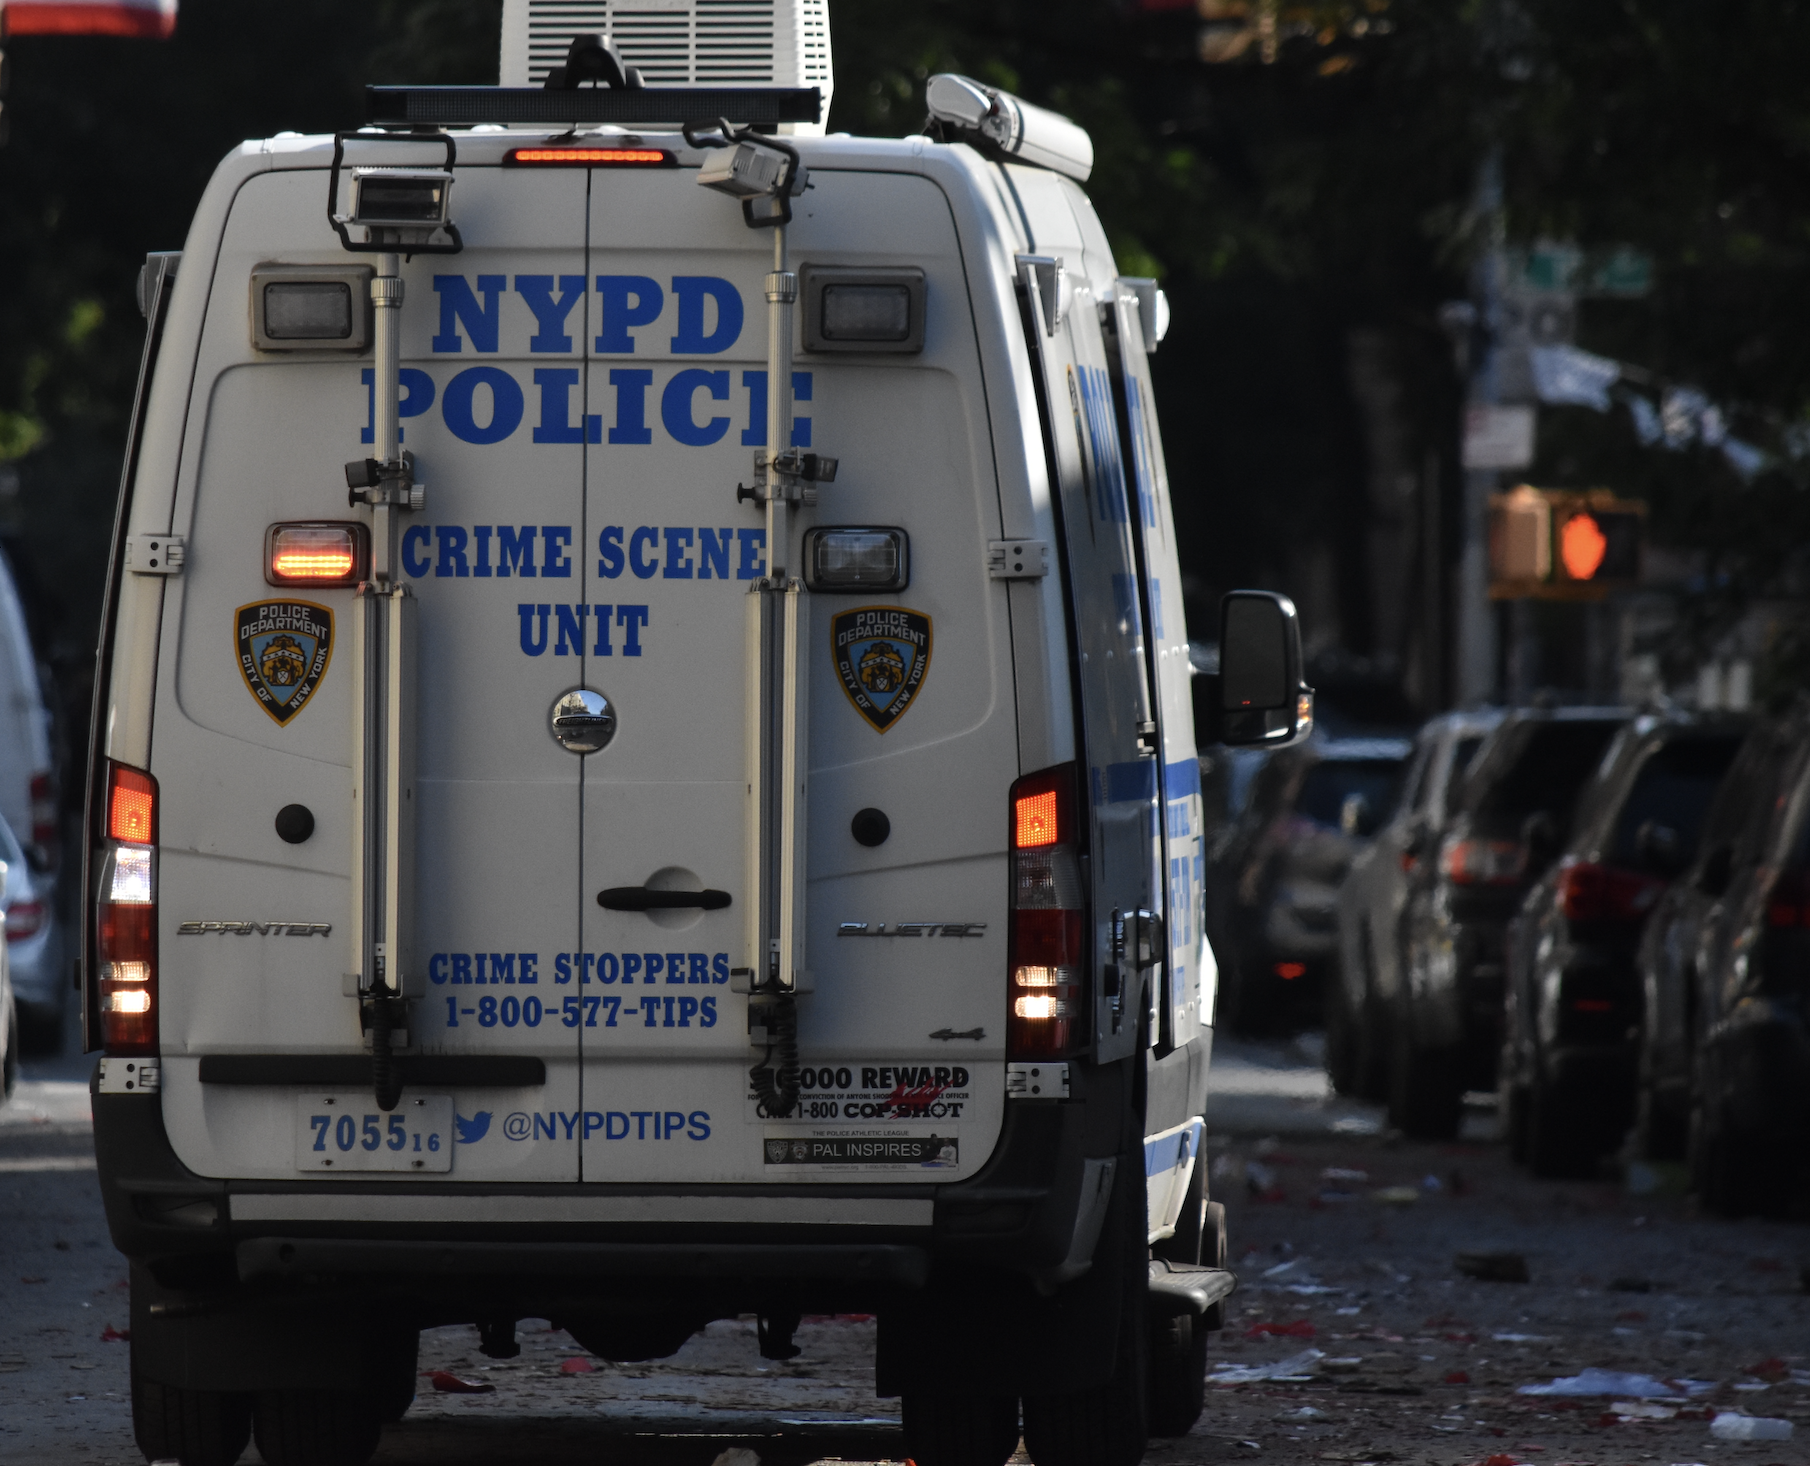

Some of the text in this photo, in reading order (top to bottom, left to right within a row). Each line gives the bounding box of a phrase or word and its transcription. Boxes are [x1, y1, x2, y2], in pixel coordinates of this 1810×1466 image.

[433, 275, 743, 354] NYPD
[361, 366, 812, 447] POLICE
[402, 525, 767, 580] CRIME SCENE
[259, 605, 310, 620] POLICE
[857, 612, 908, 627] POLICE
[241, 618, 327, 639] DEPARTMENT
[518, 604, 648, 657] UNIT
[839, 624, 926, 646] DEPARTMENT
[242, 647, 327, 708] CITY OF NEW YORK
[840, 654, 926, 715] CITY OF NEW YORK
[177, 920, 332, 937] SPRINTER
[837, 922, 987, 937] BLUETEC
[429, 953, 729, 985] CRIME STOPPERS
[447, 996, 717, 1028] 1-800-577-TIPS
[862, 1067, 969, 1089] REWARD
[797, 1102, 838, 1118] 1-800
[844, 1101, 963, 1119] COP-SHOT
[800, 1093, 835, 1101] CONVICTION
[836, 1093, 845, 1101] OF
[846, 1093, 870, 1101] ANYONE
[312, 1116, 440, 1152] 7055 16
[503, 1111, 711, 1141] @NYPDTIPS
[813, 1144, 842, 1157] PAL
[846, 1144, 922, 1157] INSPIRES
